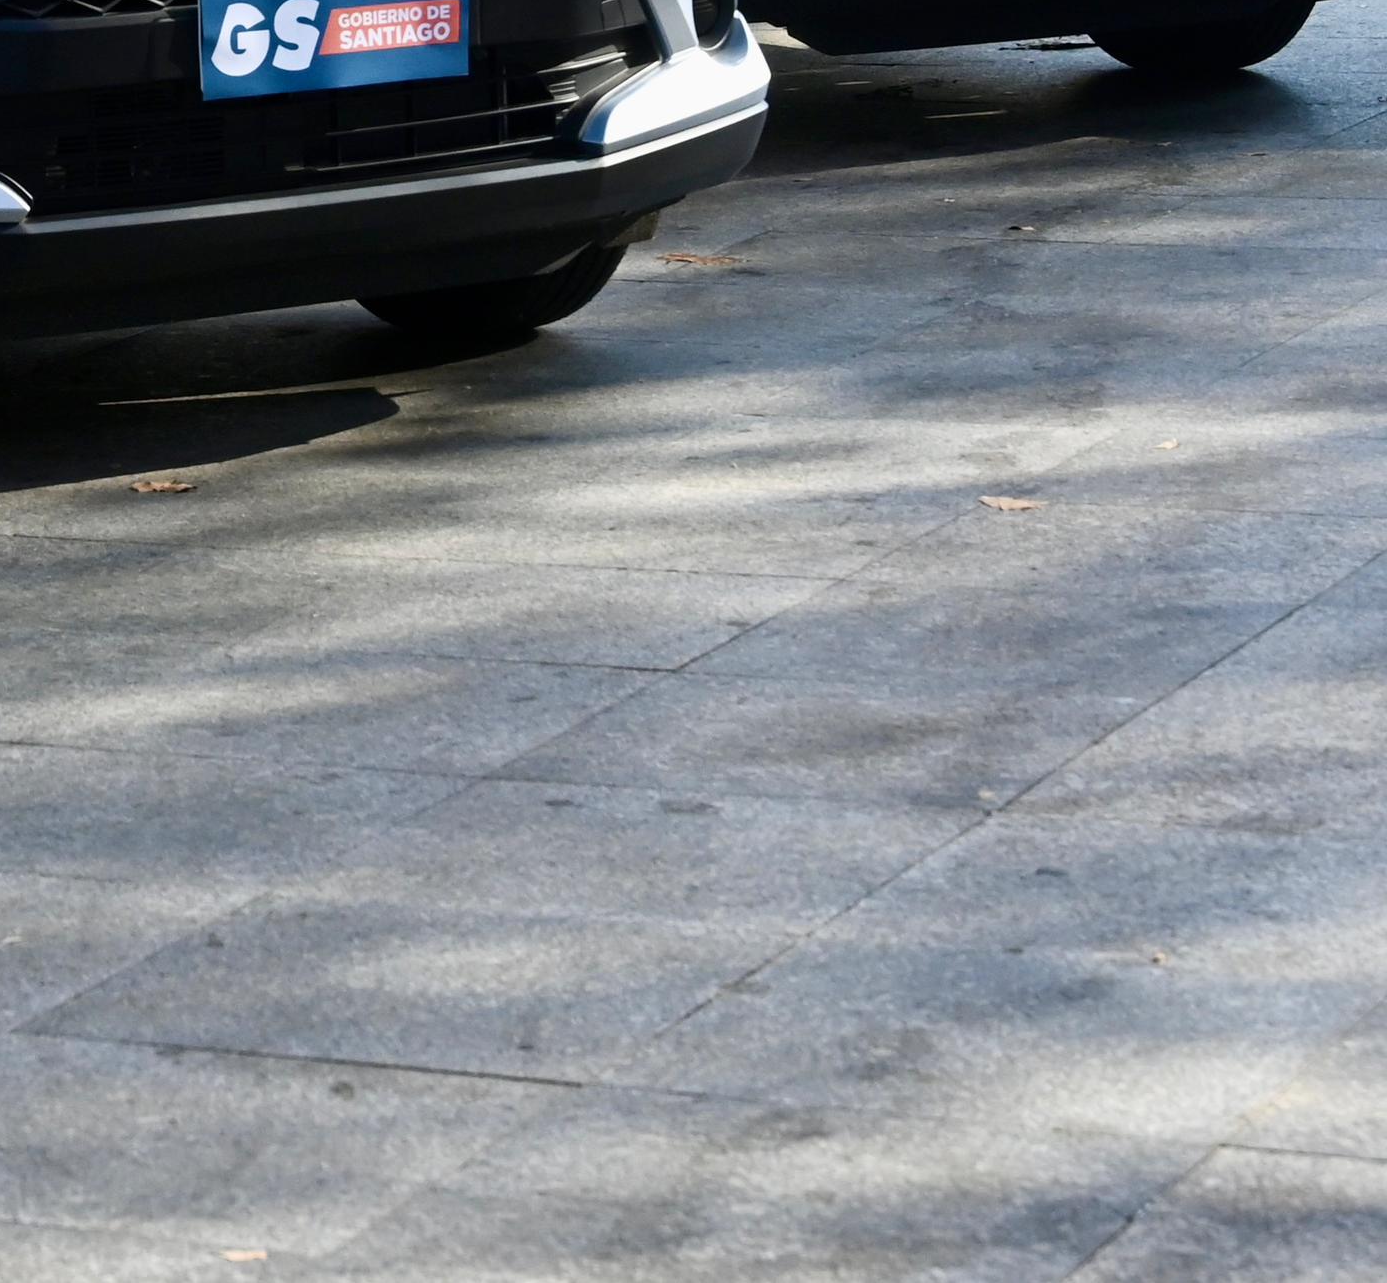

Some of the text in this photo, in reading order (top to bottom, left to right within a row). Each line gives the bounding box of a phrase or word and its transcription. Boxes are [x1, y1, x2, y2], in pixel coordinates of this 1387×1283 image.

[338, 4, 451, 28] GOBIERNO DE
[339, 21, 451, 50] SANTIAGO
